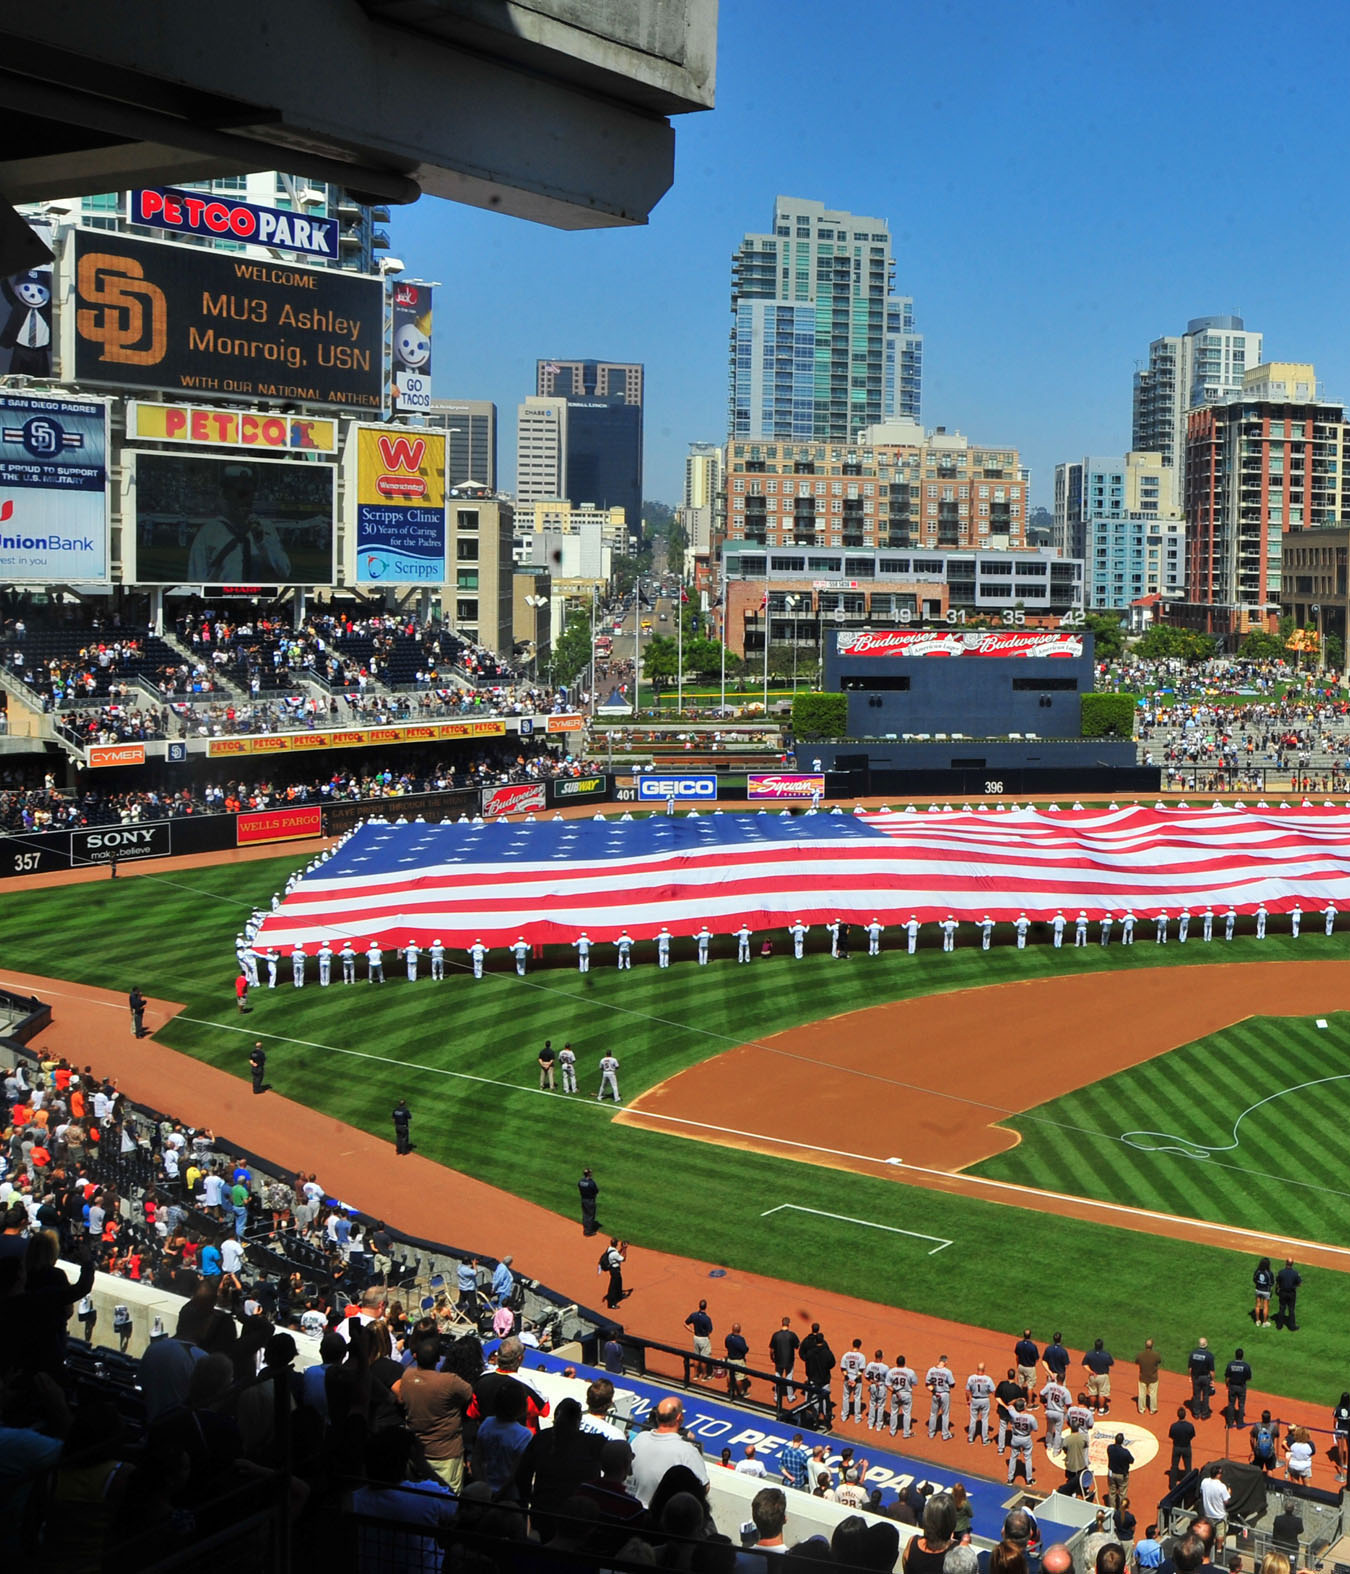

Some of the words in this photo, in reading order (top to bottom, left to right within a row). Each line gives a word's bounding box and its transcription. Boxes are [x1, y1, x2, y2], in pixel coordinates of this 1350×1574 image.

[141, 189, 256, 237] PETCO
[258, 211, 331, 253] PARK
[234, 264, 318, 289] WELCOME
[77, 253, 167, 366] SD
[202, 292, 268, 322] MU3
[279, 304, 361, 341] Ashley
[189, 327, 308, 368] Monroig,
[318, 344, 371, 371] USN
[181, 375, 218, 389] WITH
[224, 380, 252, 392] OUR
[258, 384, 321, 399] NATIONAL
[328, 391, 380, 406] ANTHEM
[407, 379, 422, 391] GO
[8, 399, 28, 407] SAN
[31, 401, 59, 410] DIEGO
[61, 404, 97, 414] PADRES
[401, 393, 430, 406] TACOS
[166, 408, 287, 446] PETCO
[31, 422, 56, 451] SD
[8, 465, 40, 473] PROUD
[57, 468, 98, 477] SUPPORT
[362, 508, 403, 524] Scripps
[407, 509, 440, 523] Clinic
[362, 523, 377, 535] 30
[378, 525, 398, 534] Years
[400, 526, 409, 534] of
[410, 527, 437, 537] Caring
[390, 537, 401, 545] for
[404, 538, 416, 546] the
[418, 538, 441, 547] Padres
[29, 558, 47, 566] you
[394, 561, 438, 577] Scripps
[834, 608, 846, 622] 6
[892, 608, 911, 622] 19
[946, 609, 966, 624] 31
[1003, 610, 1025, 624] 35
[1063, 611, 1086, 625] 42
[854, 632, 938, 652] Budweiser
[978, 634, 1061, 653] Budweiser
[441, 726, 465, 734] PETCO
[475, 723, 497, 732] PETCO
[549, 720, 581, 729] CYMER
[333, 733, 361, 742] PETCO
[370, 730, 398, 739] PETCO
[407, 728, 431, 736] PETCO
[211, 741, 241, 750] PETCO
[254, 738, 283, 748] PETCO
[294, 736, 322, 745] PETCO
[92, 750, 143, 761] CYMER
[561, 780, 599, 794] SUBWAY
[642, 781, 714, 795] GEICO
[757, 777, 815, 796] Sycuan
[985, 782, 1004, 794] 396
[485, 784, 545, 813] Budweiser
[616, 789, 635, 801] 401
[239, 820, 280, 833] WELLS
[282, 815, 319, 828] FARGO
[87, 829, 156, 848] SONY
[91, 846, 151, 860] mak.believe
[14, 852, 41, 871] 357
[893, 1377, 906, 1387] 48
[977, 1384, 981, 1392] 1
[1050, 1393, 1060, 1402] 16
[686, 1413, 733, 1437] TO
[1014, 1422, 1029, 1431] 23
